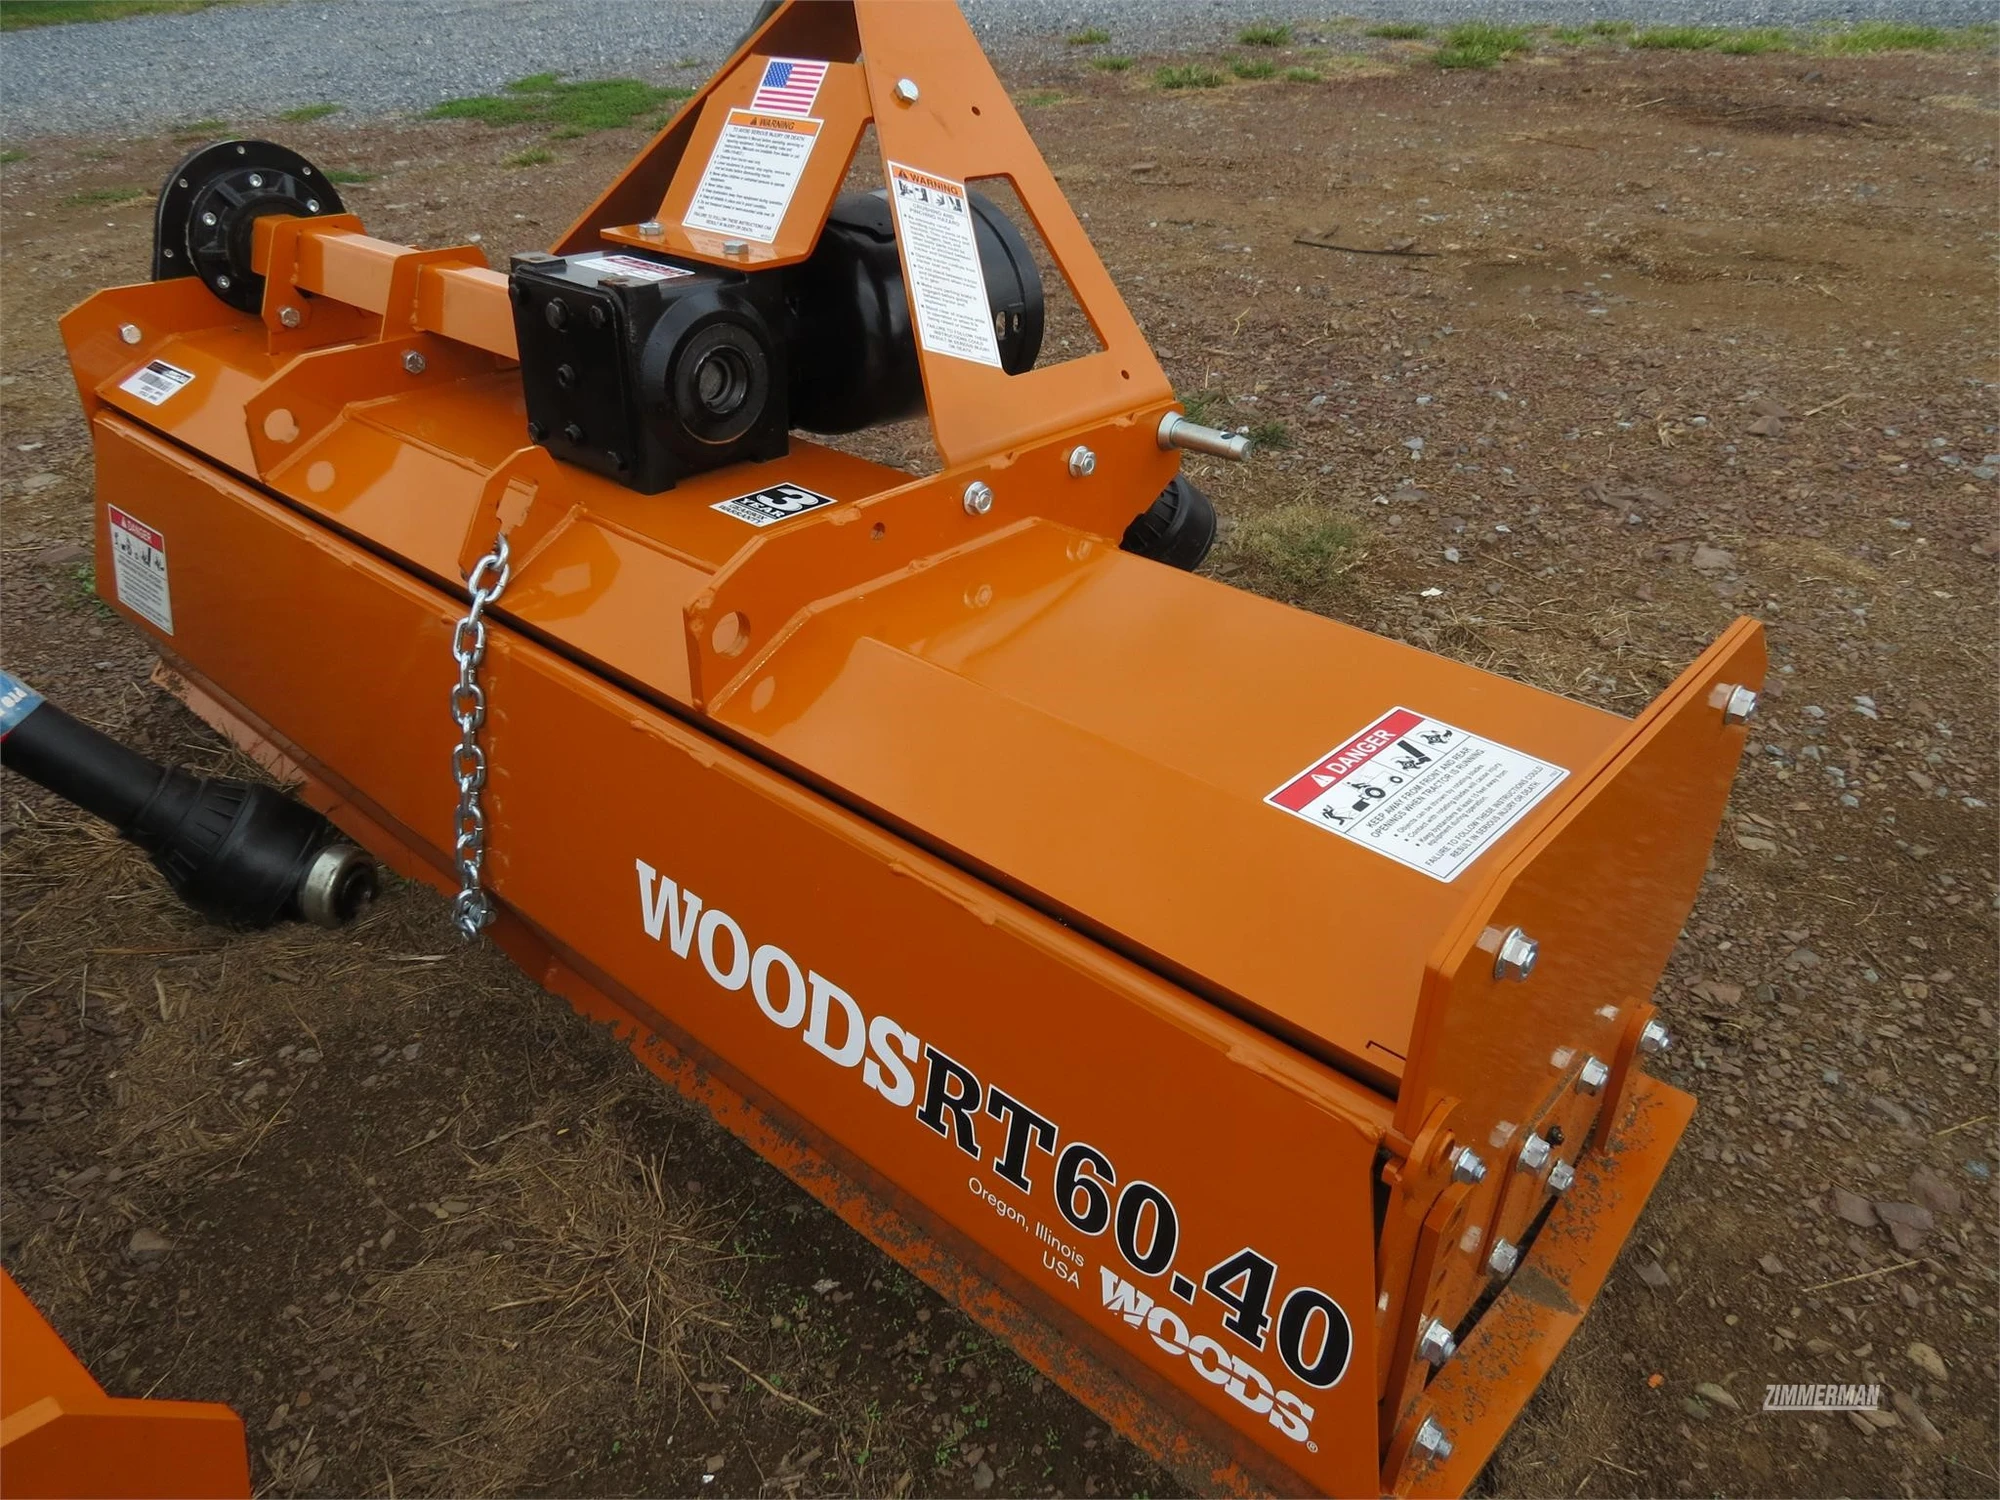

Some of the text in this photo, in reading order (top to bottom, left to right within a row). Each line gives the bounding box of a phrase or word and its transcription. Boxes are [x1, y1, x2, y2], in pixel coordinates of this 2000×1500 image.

[758, 118, 796, 130] WARNING
[910, 173, 958, 195] WARNING
[740, 498, 785, 517] YEAR
[757, 488, 819, 511] 3
[1324, 728, 1397, 774] DANGER
[1364, 746, 1472, 828] KEEP AWAY FROM FRONT AND REAR
[1369, 810, 1407, 838] OPENINGS
[1401, 795, 1426, 812] WHEN
[1421, 773, 1454, 797] TRACTOR
[1424, 766, 1544, 865] FAILURE TO FOLLOW THESE INSTRUCTIONS COULD
[1448, 839, 1473, 858] RESULT
[1474, 815, 1501, 835] SERIOUS
[1496, 800, 1518, 816] INJURY
[1513, 794, 1525, 802] OR
[636, 858, 1352, 1389] WOODS RT60.40
[968, 1177, 1085, 1268] Oregon, Illinois
[1042, 1250, 1081, 1289] USA
[1099, 1266, 1314, 1442] WOODS
